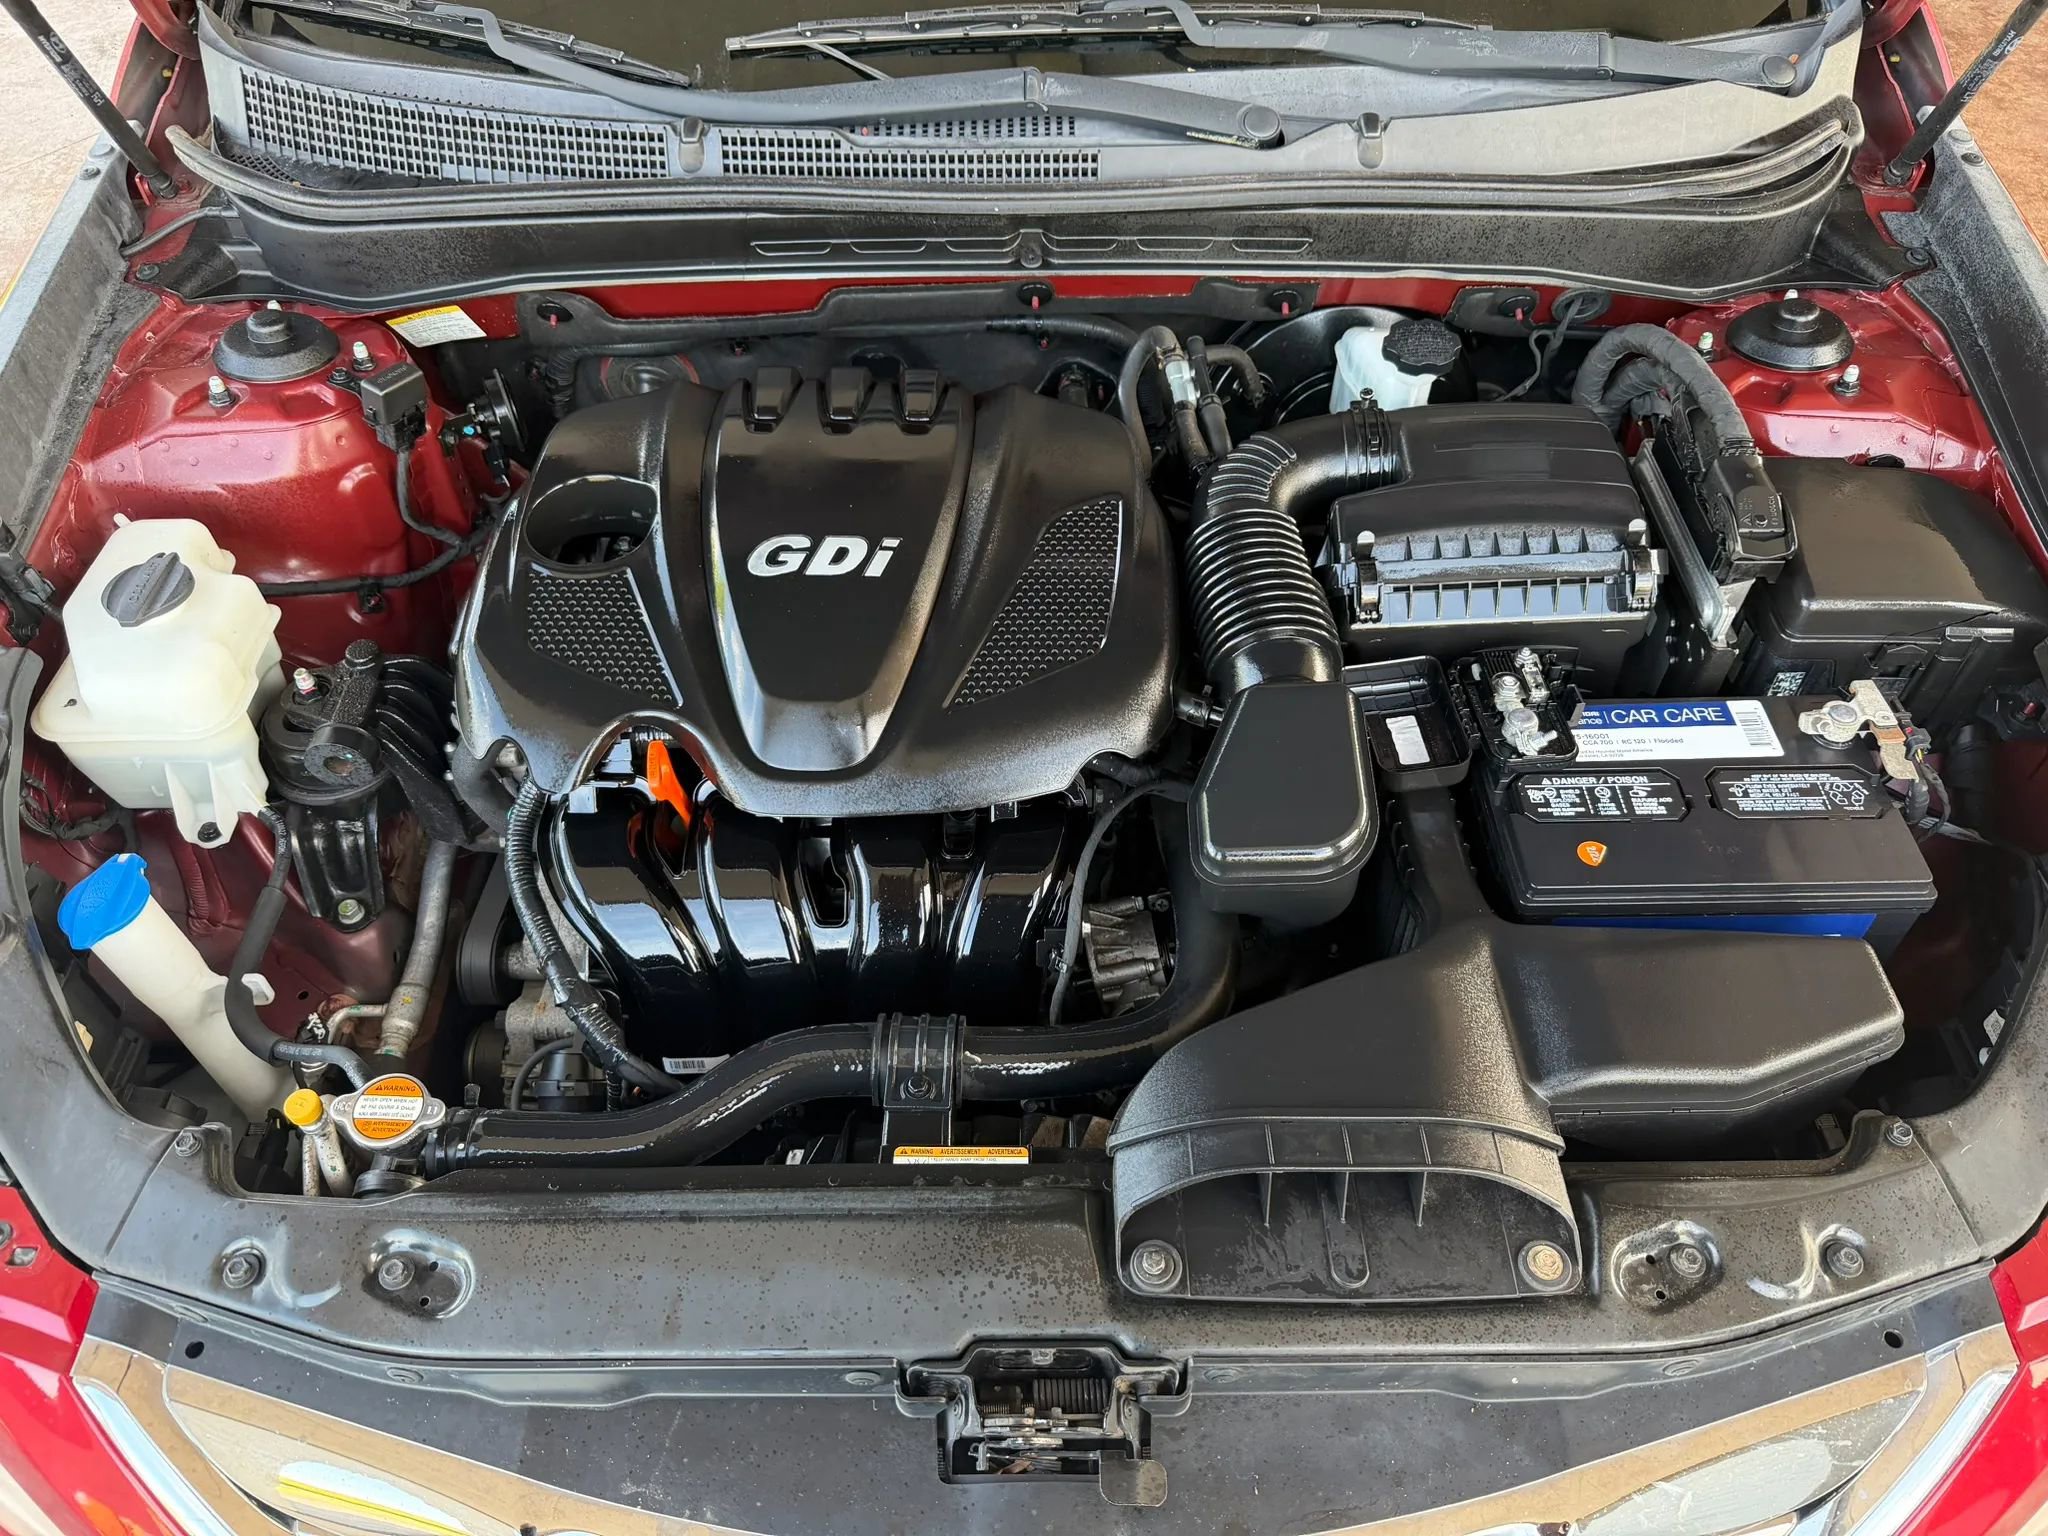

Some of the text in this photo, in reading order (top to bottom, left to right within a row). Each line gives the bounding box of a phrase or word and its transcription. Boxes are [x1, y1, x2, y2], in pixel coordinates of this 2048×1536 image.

[747, 534, 903, 577] GDi
[1611, 707, 1726, 724] CAR CARE
[1607, 776, 1648, 784] POISON
